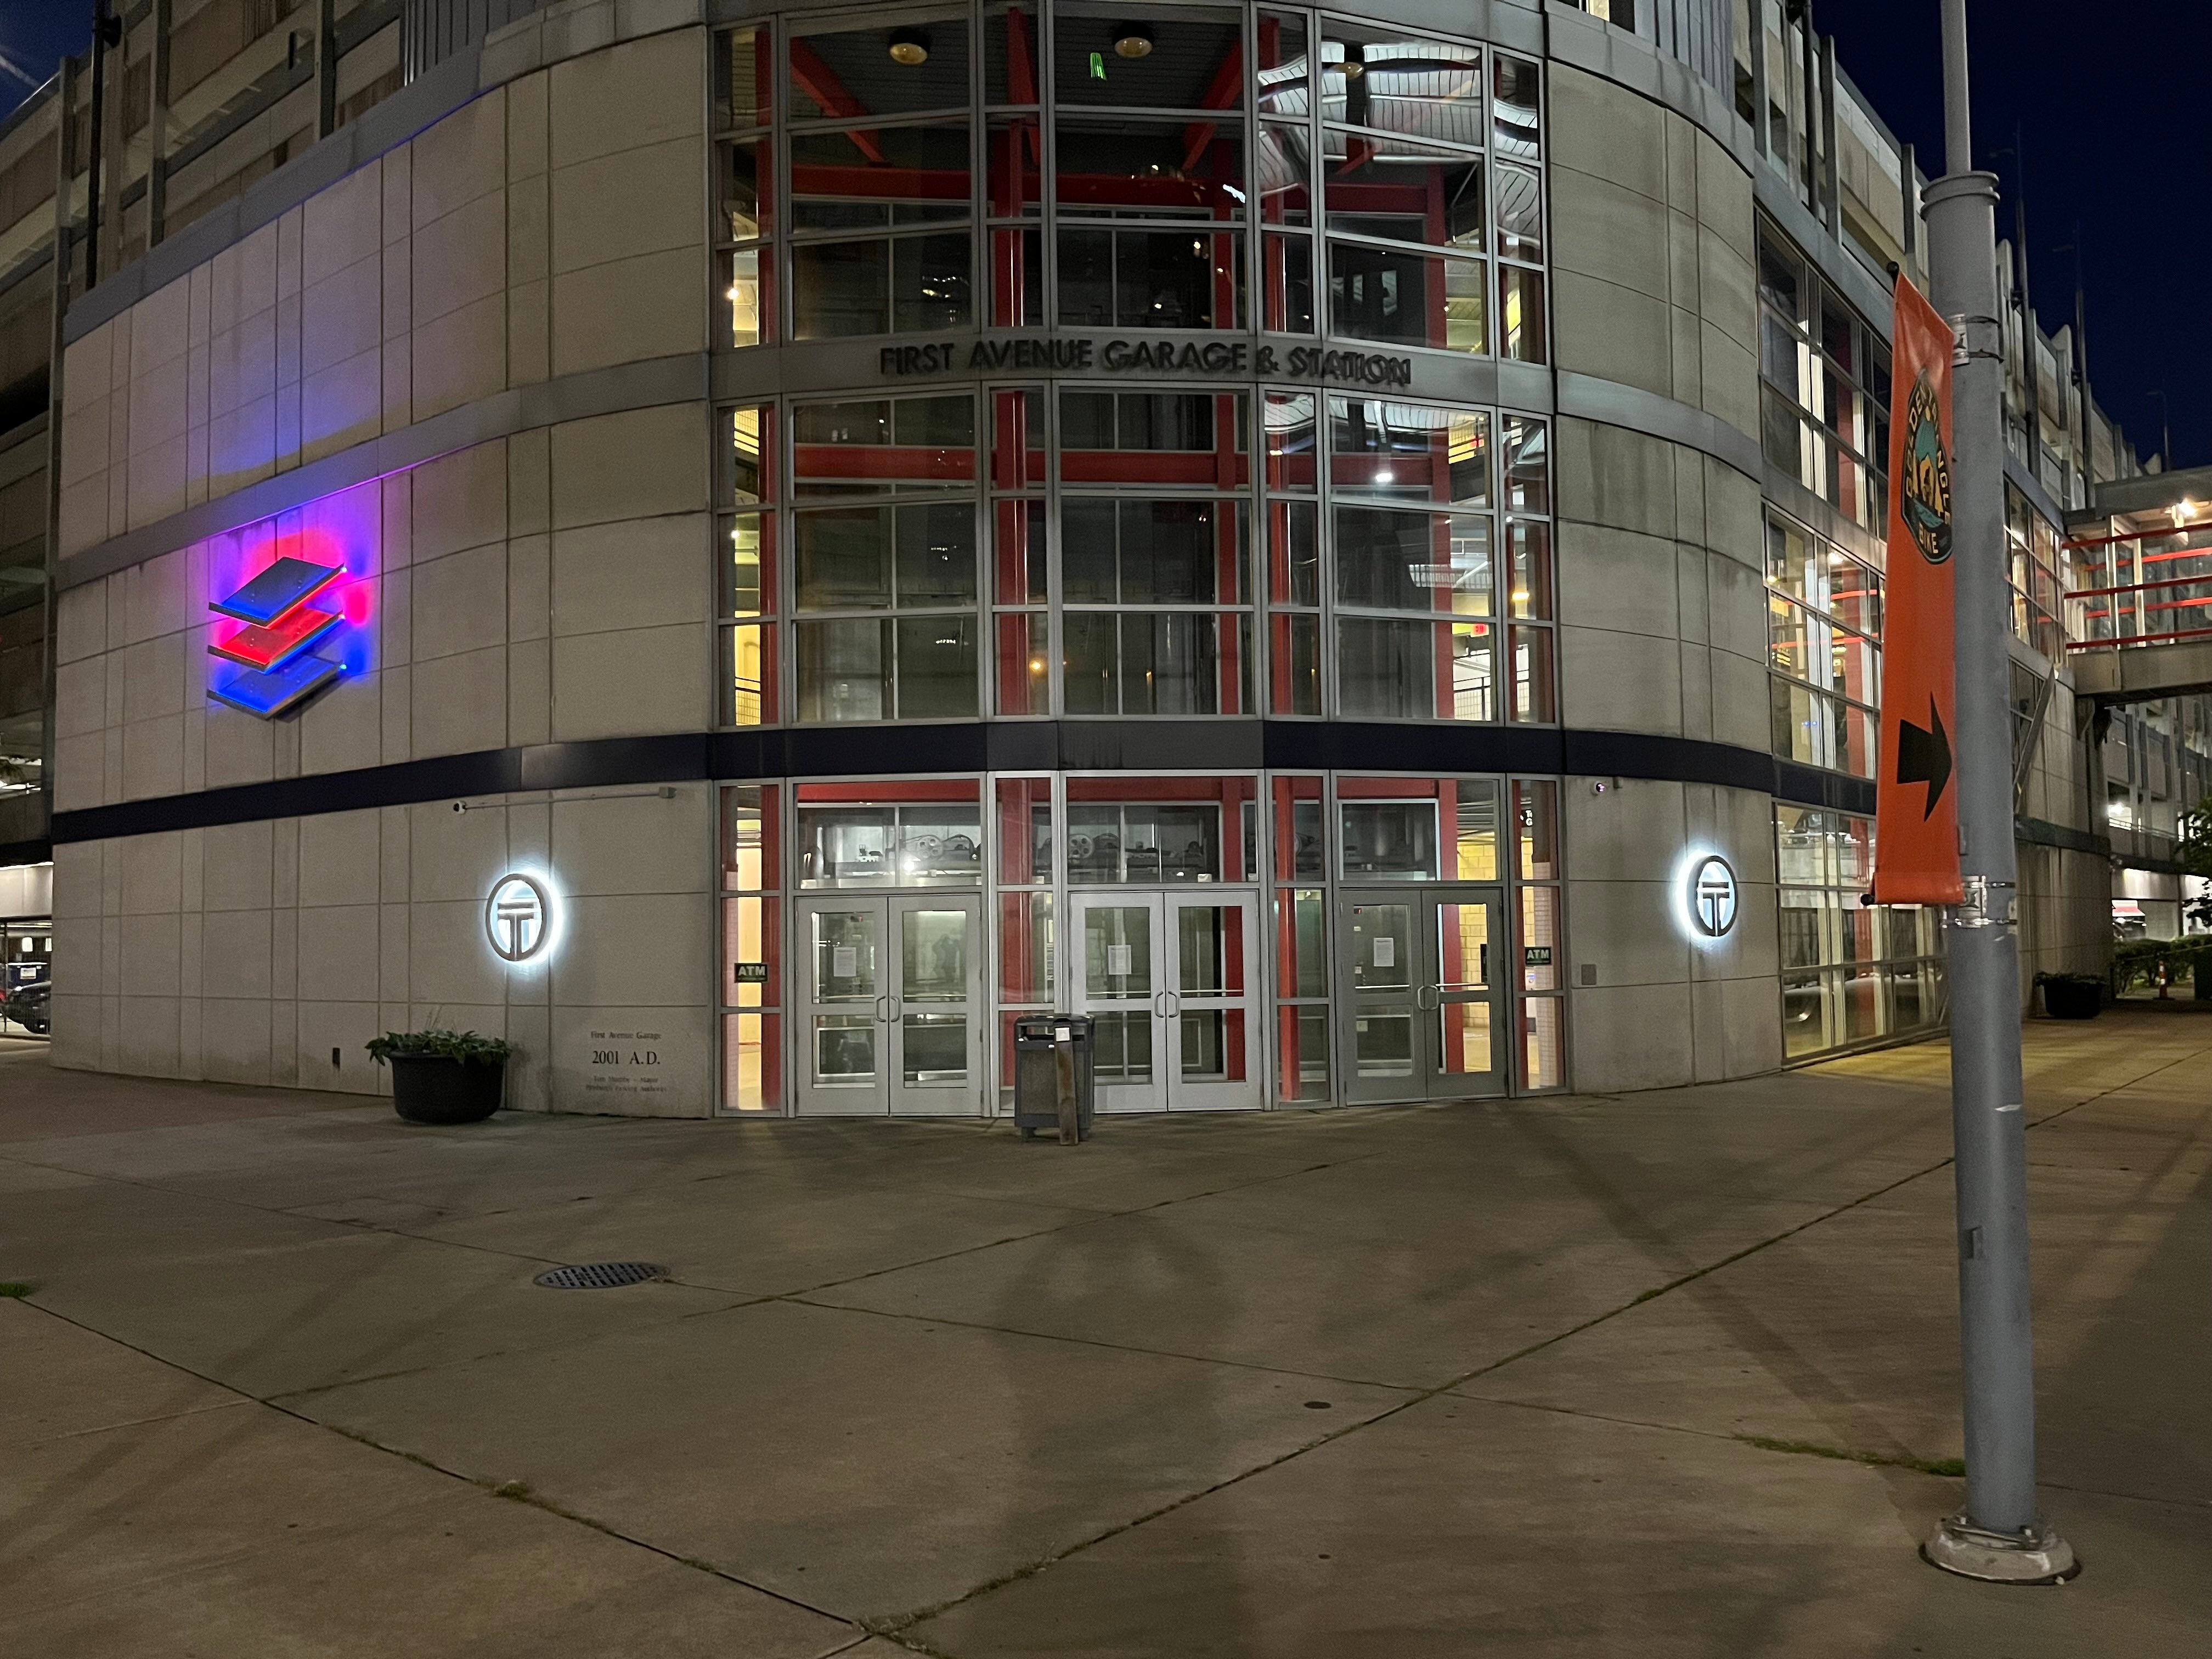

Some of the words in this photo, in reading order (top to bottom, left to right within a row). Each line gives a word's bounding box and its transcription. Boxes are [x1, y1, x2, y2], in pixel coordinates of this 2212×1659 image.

[880, 343, 954, 375] FIRST
[969, 339, 1093, 370] AVENUE
[1103, 340, 1247, 372] GARAGE
[1258, 346, 1280, 375] &
[1288, 346, 1411, 384] STATION
[1919, 522, 1939, 554] BIKE
[1527, 949, 1549, 959] ATM
[738, 966, 765, 976] ATM
[592, 1051, 619, 1064] 2001
[629, 1051, 661, 1065] A.D.
